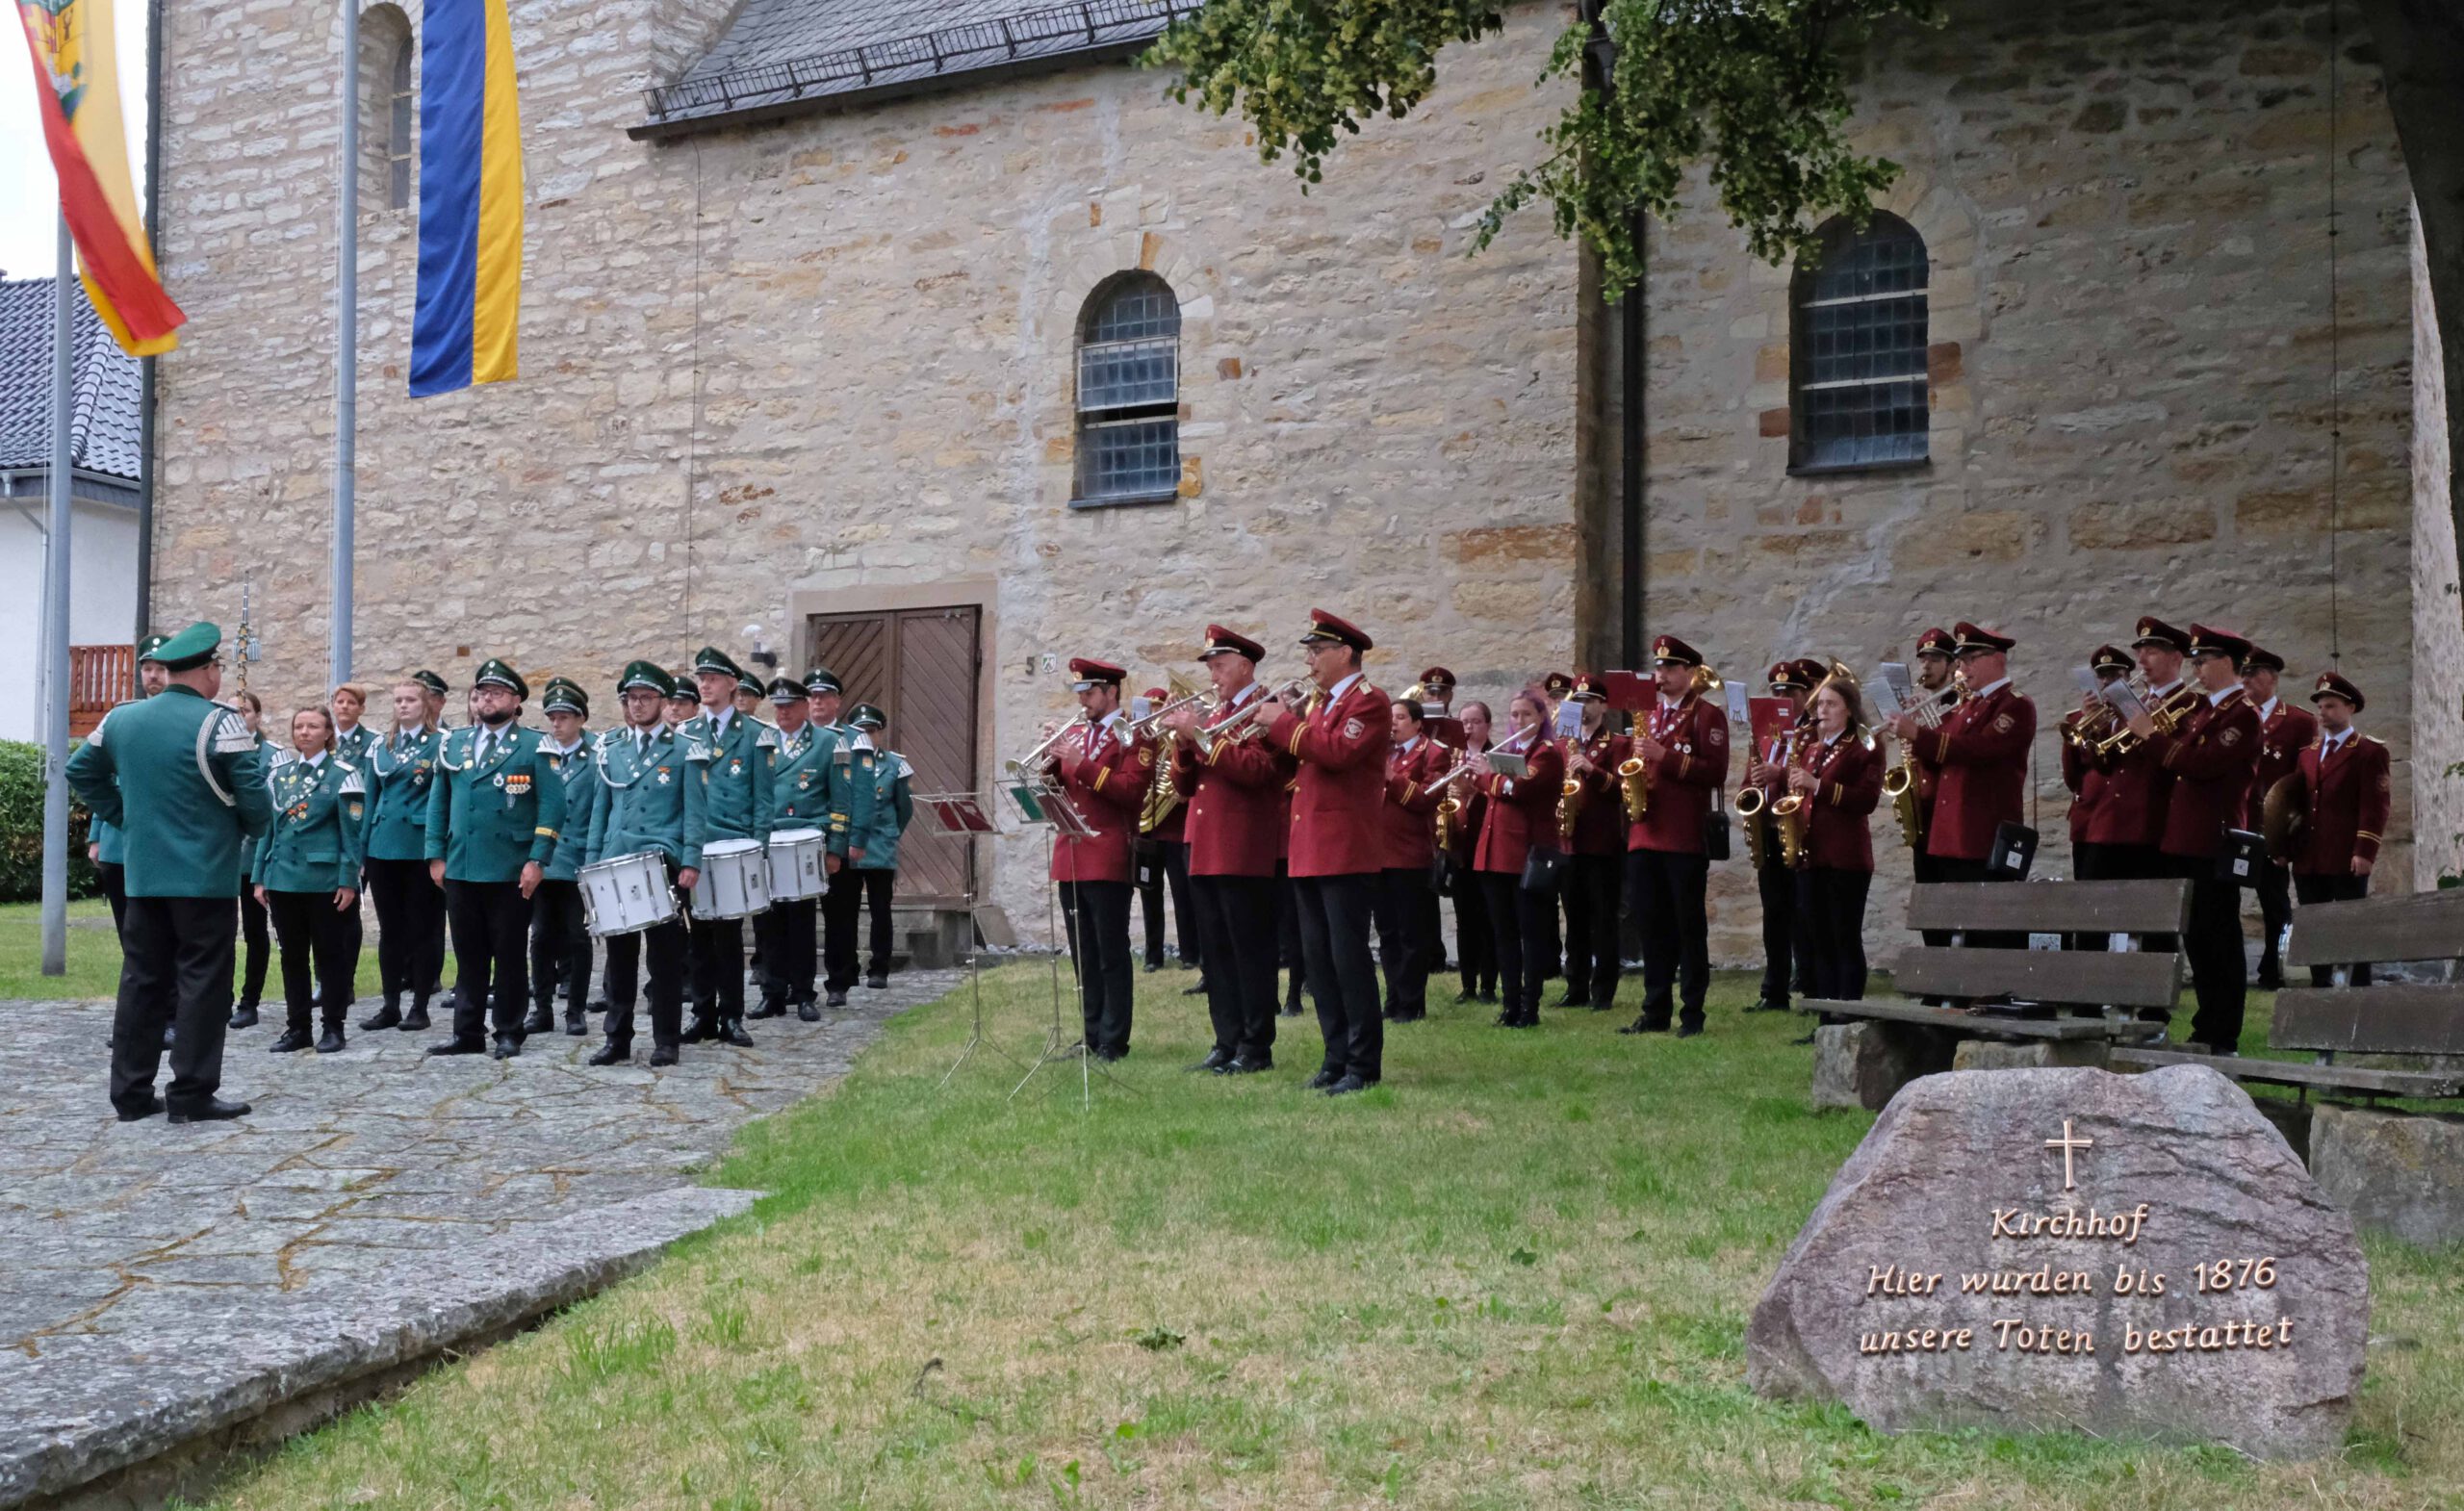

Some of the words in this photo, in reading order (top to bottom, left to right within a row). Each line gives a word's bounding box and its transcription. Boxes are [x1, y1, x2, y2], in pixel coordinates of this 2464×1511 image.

[1990, 1204, 2148, 1244] Kirchhof
[1867, 1264, 1942, 1296] Hier
[1961, 1264, 2092, 1295] wurden
[2114, 1264, 2166, 1296] bis
[2194, 1256, 2276, 1293] 1876
[1860, 1327, 1972, 1353] unsere
[1992, 1319, 2094, 1354] Toten
[2124, 1316, 2294, 1353] bestattet
